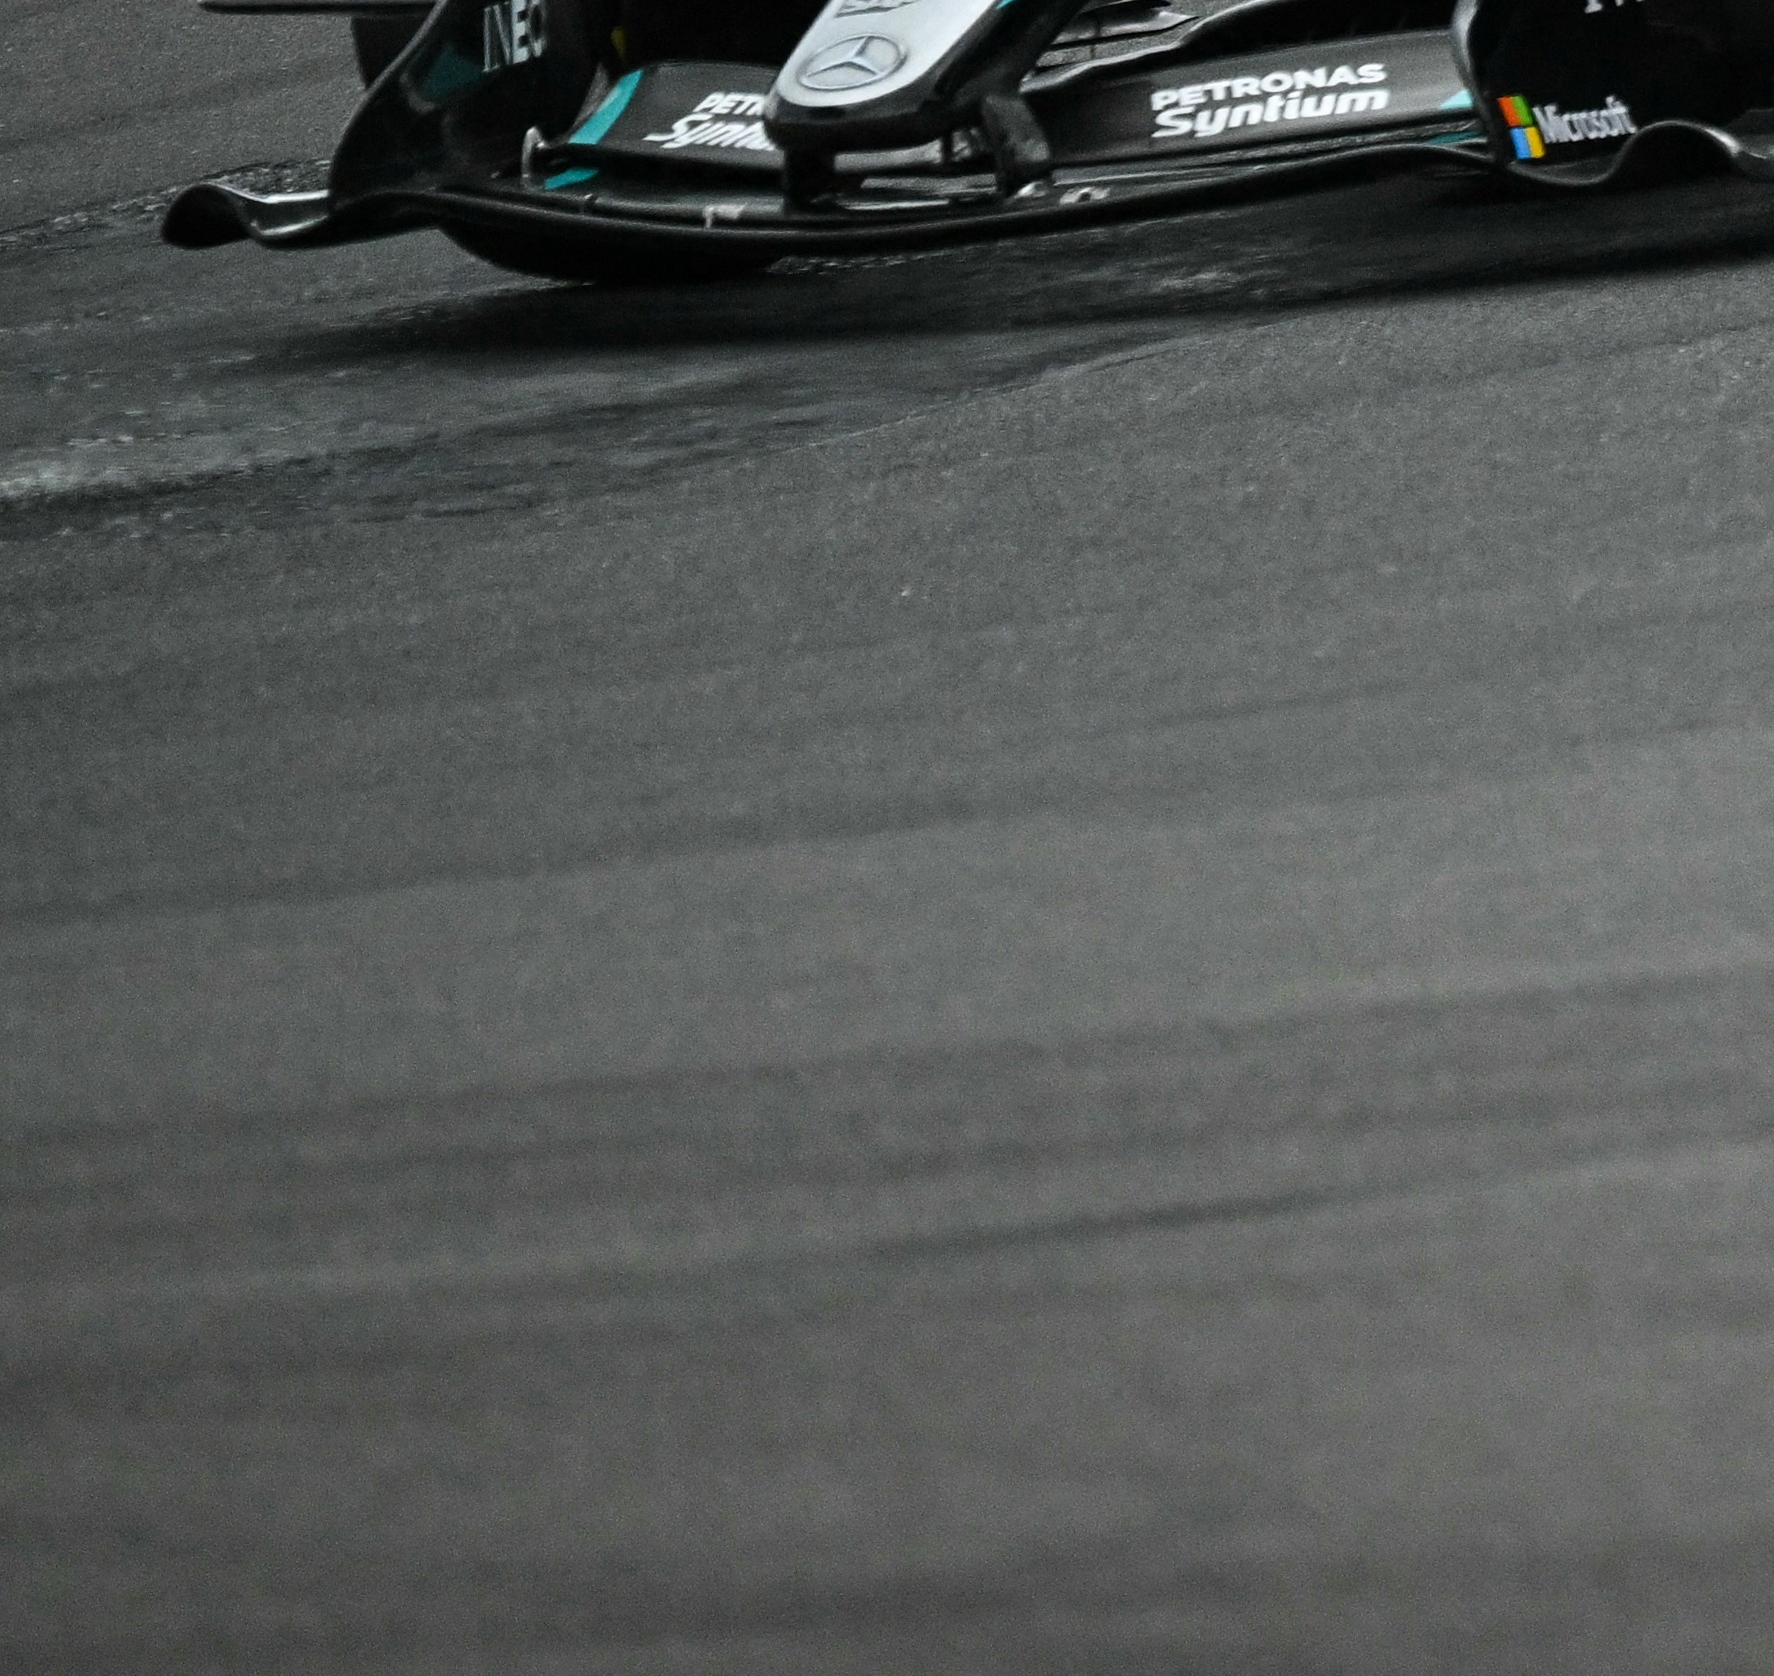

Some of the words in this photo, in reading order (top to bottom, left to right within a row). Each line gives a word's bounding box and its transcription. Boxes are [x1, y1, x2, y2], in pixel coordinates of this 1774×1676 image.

[1151, 62, 1388, 111] PETRONAS
[1150, 88, 1389, 138] Syntium
[1531, 95, 1639, 144] Microsoft
